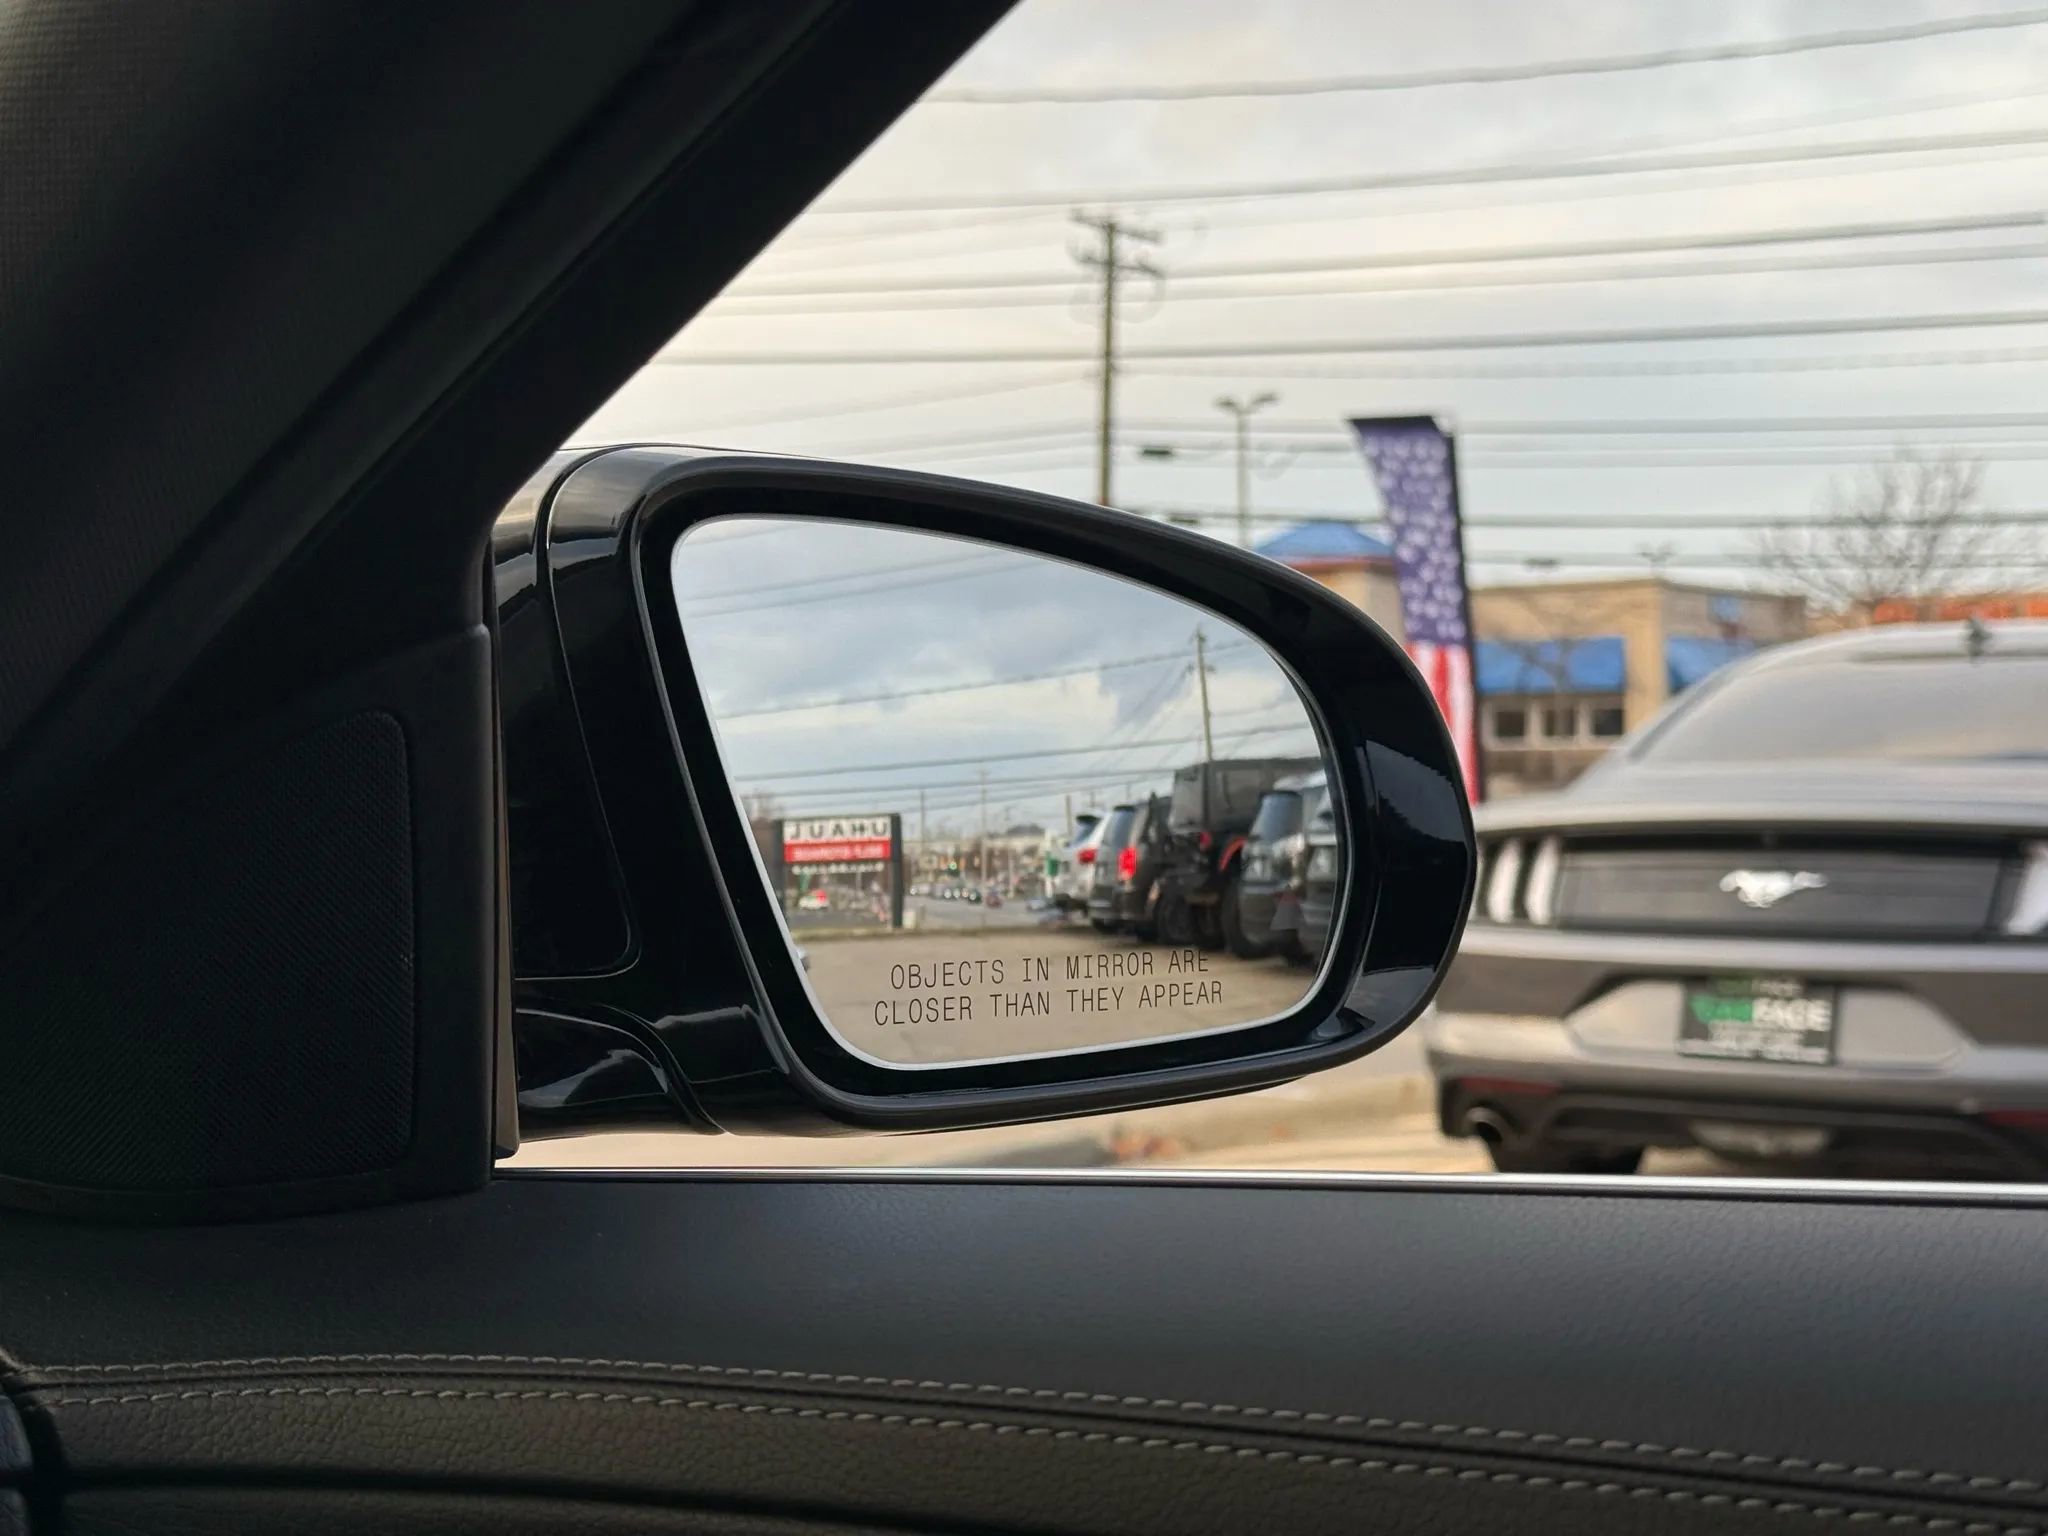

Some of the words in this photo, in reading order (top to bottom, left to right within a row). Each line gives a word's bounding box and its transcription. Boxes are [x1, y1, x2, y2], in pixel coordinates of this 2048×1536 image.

[890, 958, 1005, 990] OBJECTS
[1022, 957, 1049, 983] IN
[1066, 951, 1154, 980] MIRROR
[1167, 949, 1209, 973] ARE
[874, 995, 972, 1026] CLOSER
[989, 991, 1050, 1018] THAN
[1066, 985, 1125, 1013] THEY
[1138, 980, 1222, 1009] APPEAR
